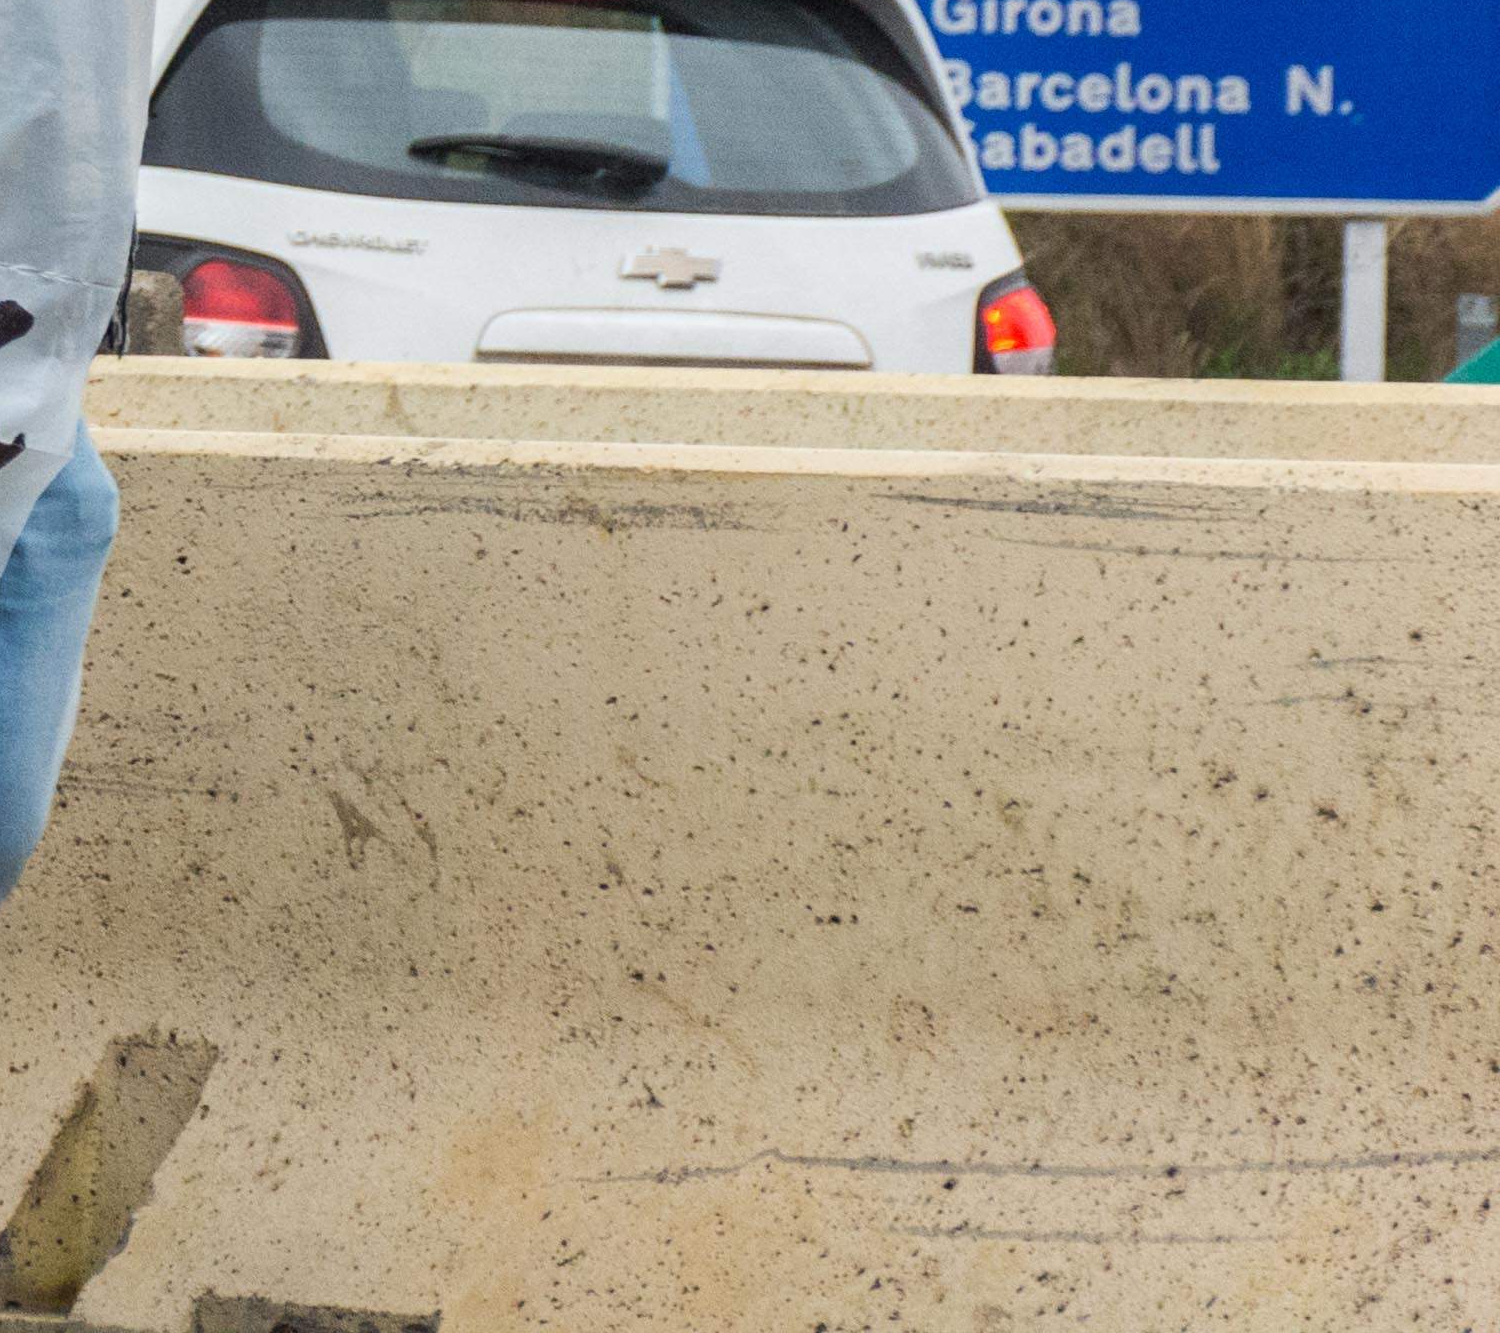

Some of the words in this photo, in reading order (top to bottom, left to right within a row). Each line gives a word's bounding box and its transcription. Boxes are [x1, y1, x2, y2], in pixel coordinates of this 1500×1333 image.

[940, 59, 1251, 115] Barcelona
[1284, 64, 1355, 117] N.
[963, 118, 1222, 175] abadell
